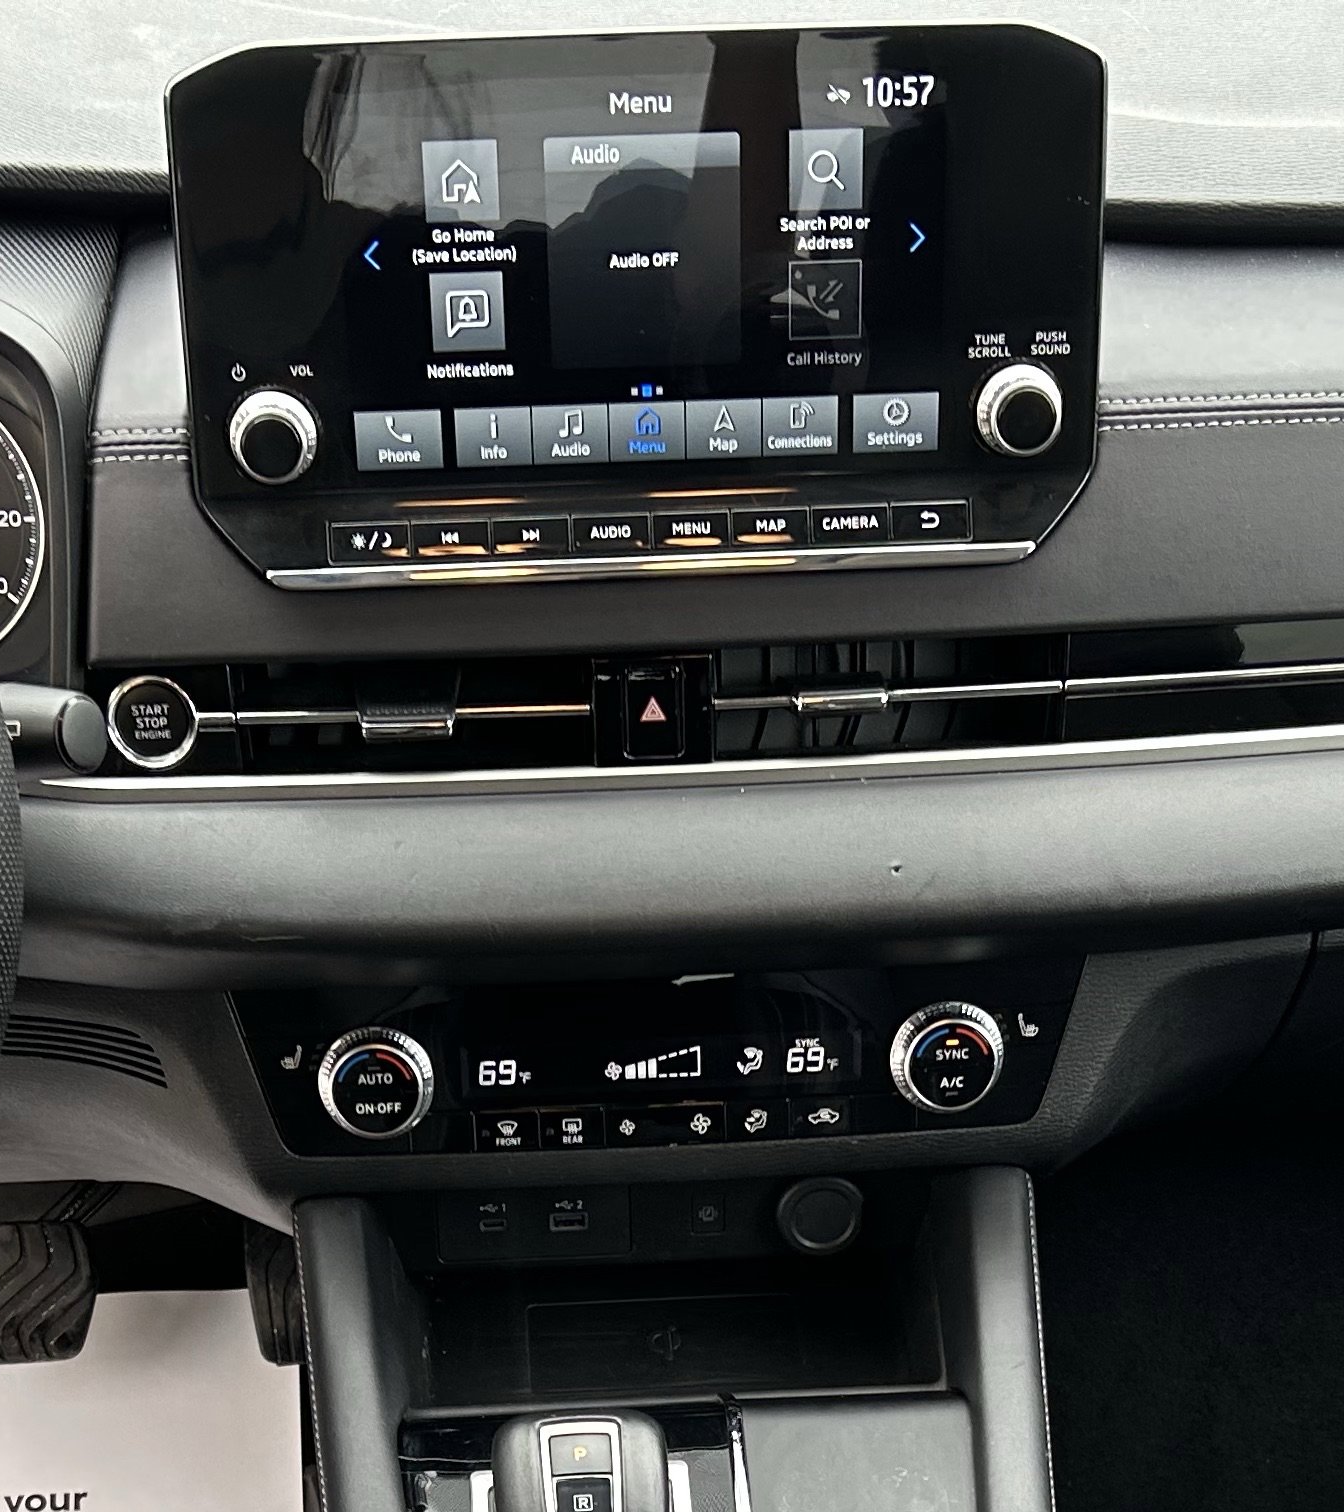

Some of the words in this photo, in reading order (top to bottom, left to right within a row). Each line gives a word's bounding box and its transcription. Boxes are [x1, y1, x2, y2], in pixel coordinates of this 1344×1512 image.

[862, 75, 935, 108] 10:57
[608, 92, 672, 115] Menu
[571, 144, 620, 165] Audio
[780, 217, 826, 232] Search
[830, 216, 853, 231] POI
[855, 216, 871, 230] or
[432, 229, 451, 244] Go
[454, 228, 495, 244] Home
[797, 235, 854, 251] Address
[412, 248, 450, 265] (Save
[452, 245, 517, 263] Location)
[609, 253, 649, 269] Audio
[653, 252, 679, 267] OFF
[974, 333, 1006, 346] TUNE
[1035, 331, 1067, 343] PUSH
[967, 346, 1011, 358] SCROLL
[1030, 343, 1071, 356] SOUND
[787, 352, 811, 366] Call
[814, 351, 863, 366] History
[289, 365, 314, 377] VOL
[427, 362, 514, 379] Notifications
[629, 440, 666, 455] Menu
[709, 436, 738, 453] Map
[767, 434, 832, 450] Connections
[867, 431, 923, 449] Settings
[378, 448, 421, 463] Phone
[480, 445, 508, 460] Info
[551, 442, 591, 458] Audio
[672, 521, 711, 535] MENU
[756, 518, 787, 533] MAP
[822, 515, 879, 531] CAMERA
[590, 525, 632, 540] AUDIO
[130, 704, 170, 717] START
[136, 717, 168, 729] STOP
[134, 729, 172, 740] ENGINE
[795, 1038, 820, 1047] SYNC
[935, 1048, 969, 1061] SYNC
[357, 1073, 393, 1086] AUTO
[939, 1076, 964, 1089] A/C
[496, 1136, 521, 1147] FRONT
[574, 1446, 587, 1461] P
